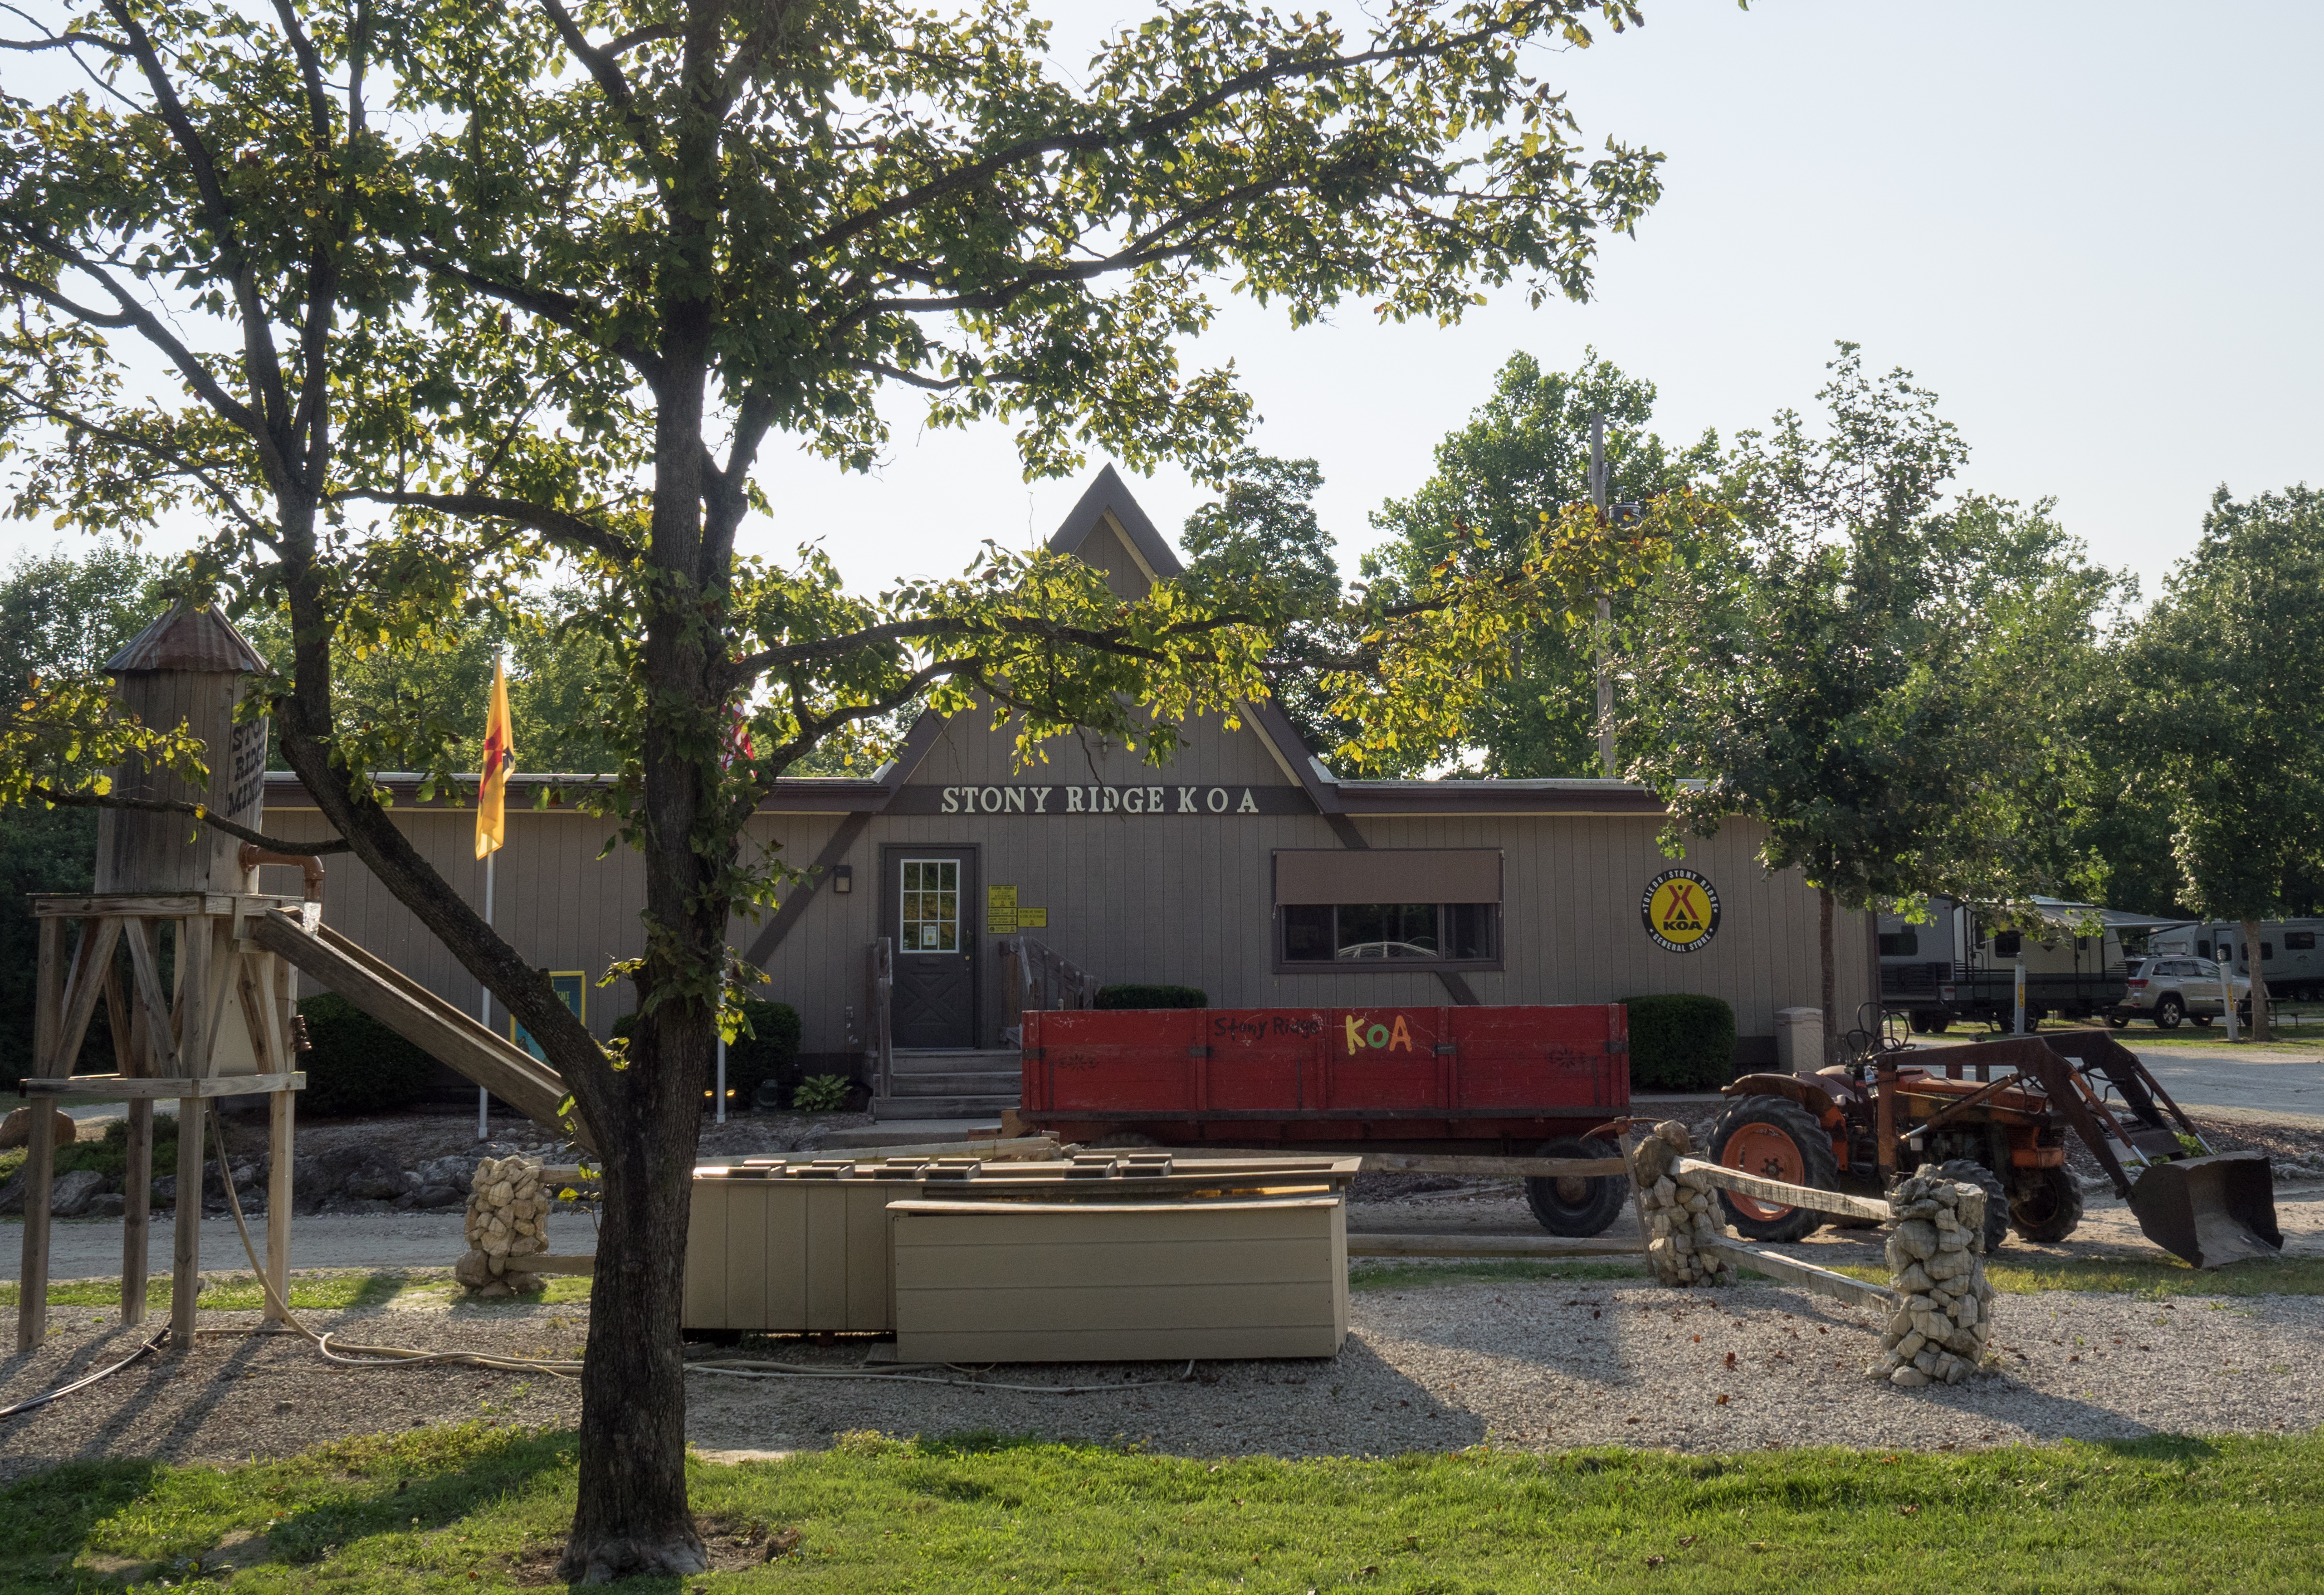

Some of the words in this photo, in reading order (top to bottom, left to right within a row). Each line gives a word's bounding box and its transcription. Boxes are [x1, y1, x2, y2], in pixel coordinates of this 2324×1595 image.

[941, 786, 1052, 813] STONY
[1066, 786, 1164, 813] RIDGE
[1700, 880, 1718, 908] RIDGE
[1663, 921, 1703, 930] KOA
[1653, 933, 1686, 952] GENERAL
[1689, 933, 1711, 950] STORE
[1214, 1017, 1268, 1041] Stony
[1273, 1016, 1320, 1039] Ridge
